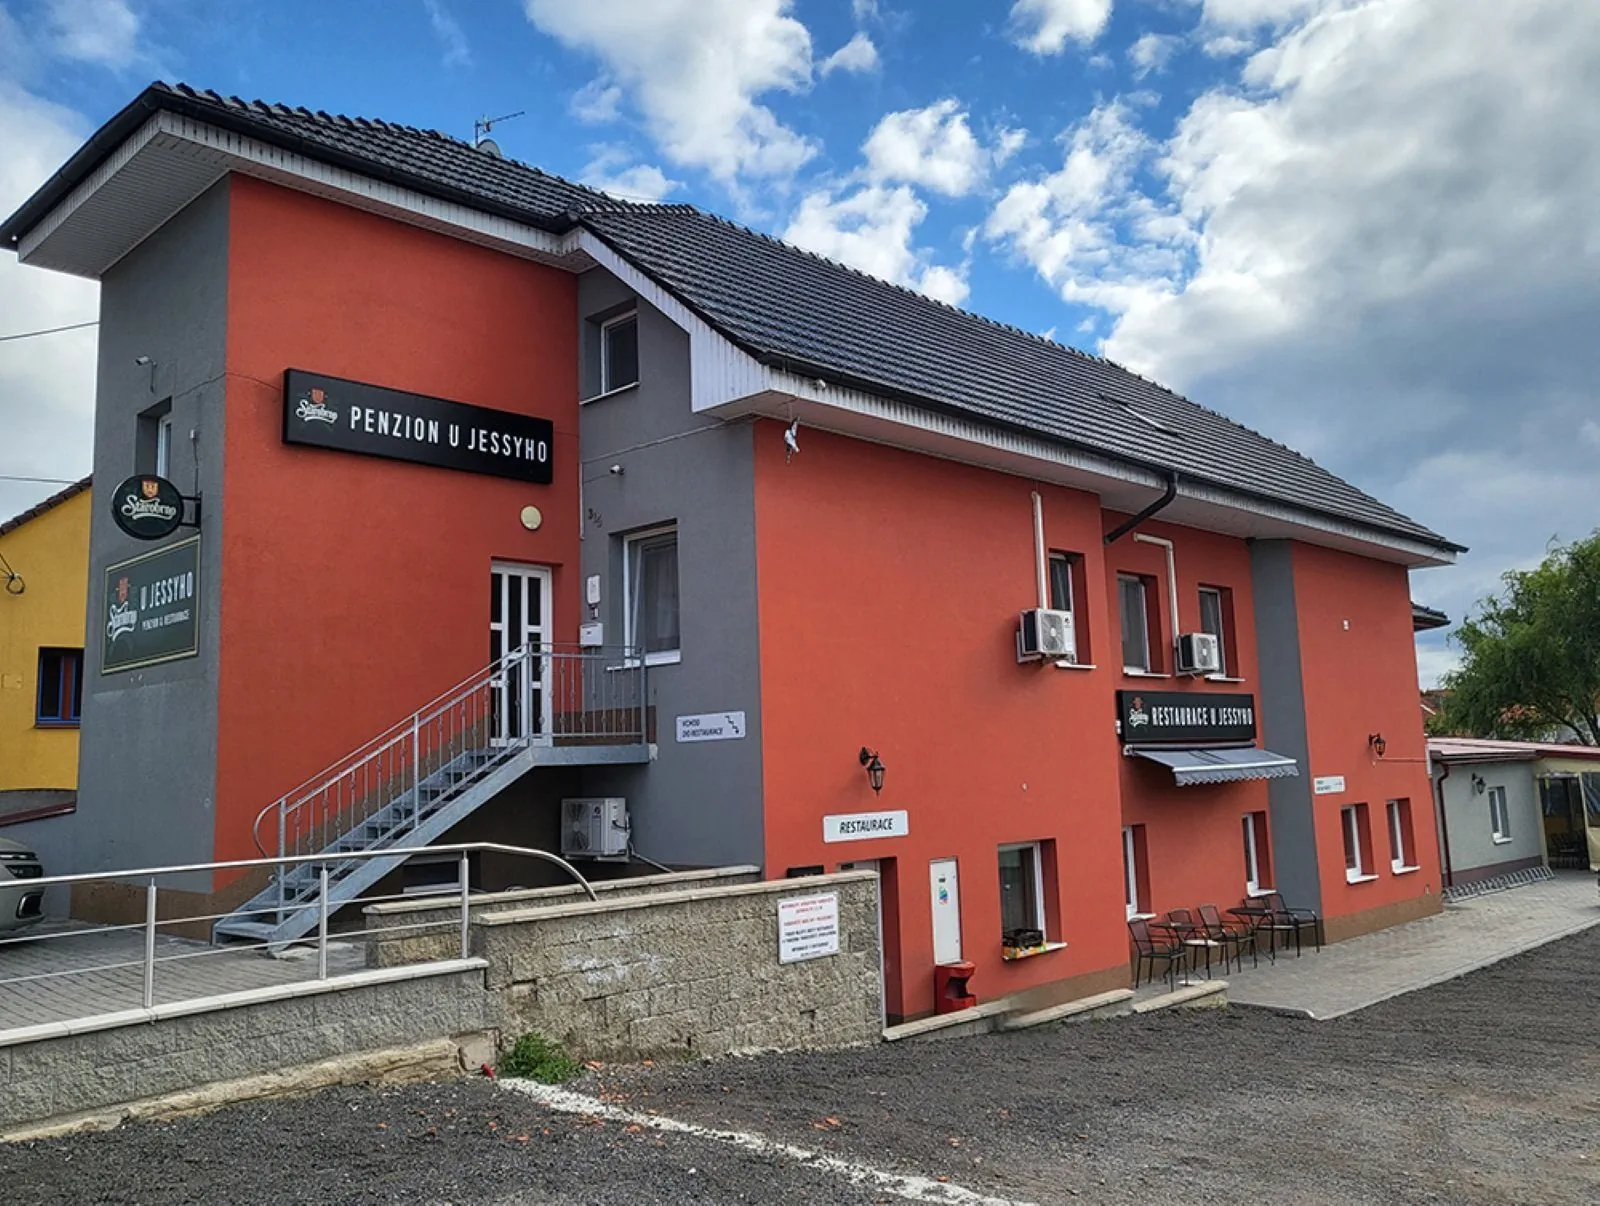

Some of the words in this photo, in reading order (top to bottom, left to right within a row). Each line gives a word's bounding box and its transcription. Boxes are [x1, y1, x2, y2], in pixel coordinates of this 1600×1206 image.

[350, 405, 439, 444] PENZION
[450, 424, 460, 447] U
[468, 428, 547, 463] JESSYHO
[121, 494, 177, 520] Starobrno
[140, 586, 147, 611] U
[149, 571, 193, 607] JESSYHO
[1152, 707, 1208, 726] RESTAURACE
[1210, 707, 1216, 725] U
[1219, 707, 1252, 725] JESSYHO
[840, 818, 893, 834] RESTAURACE
